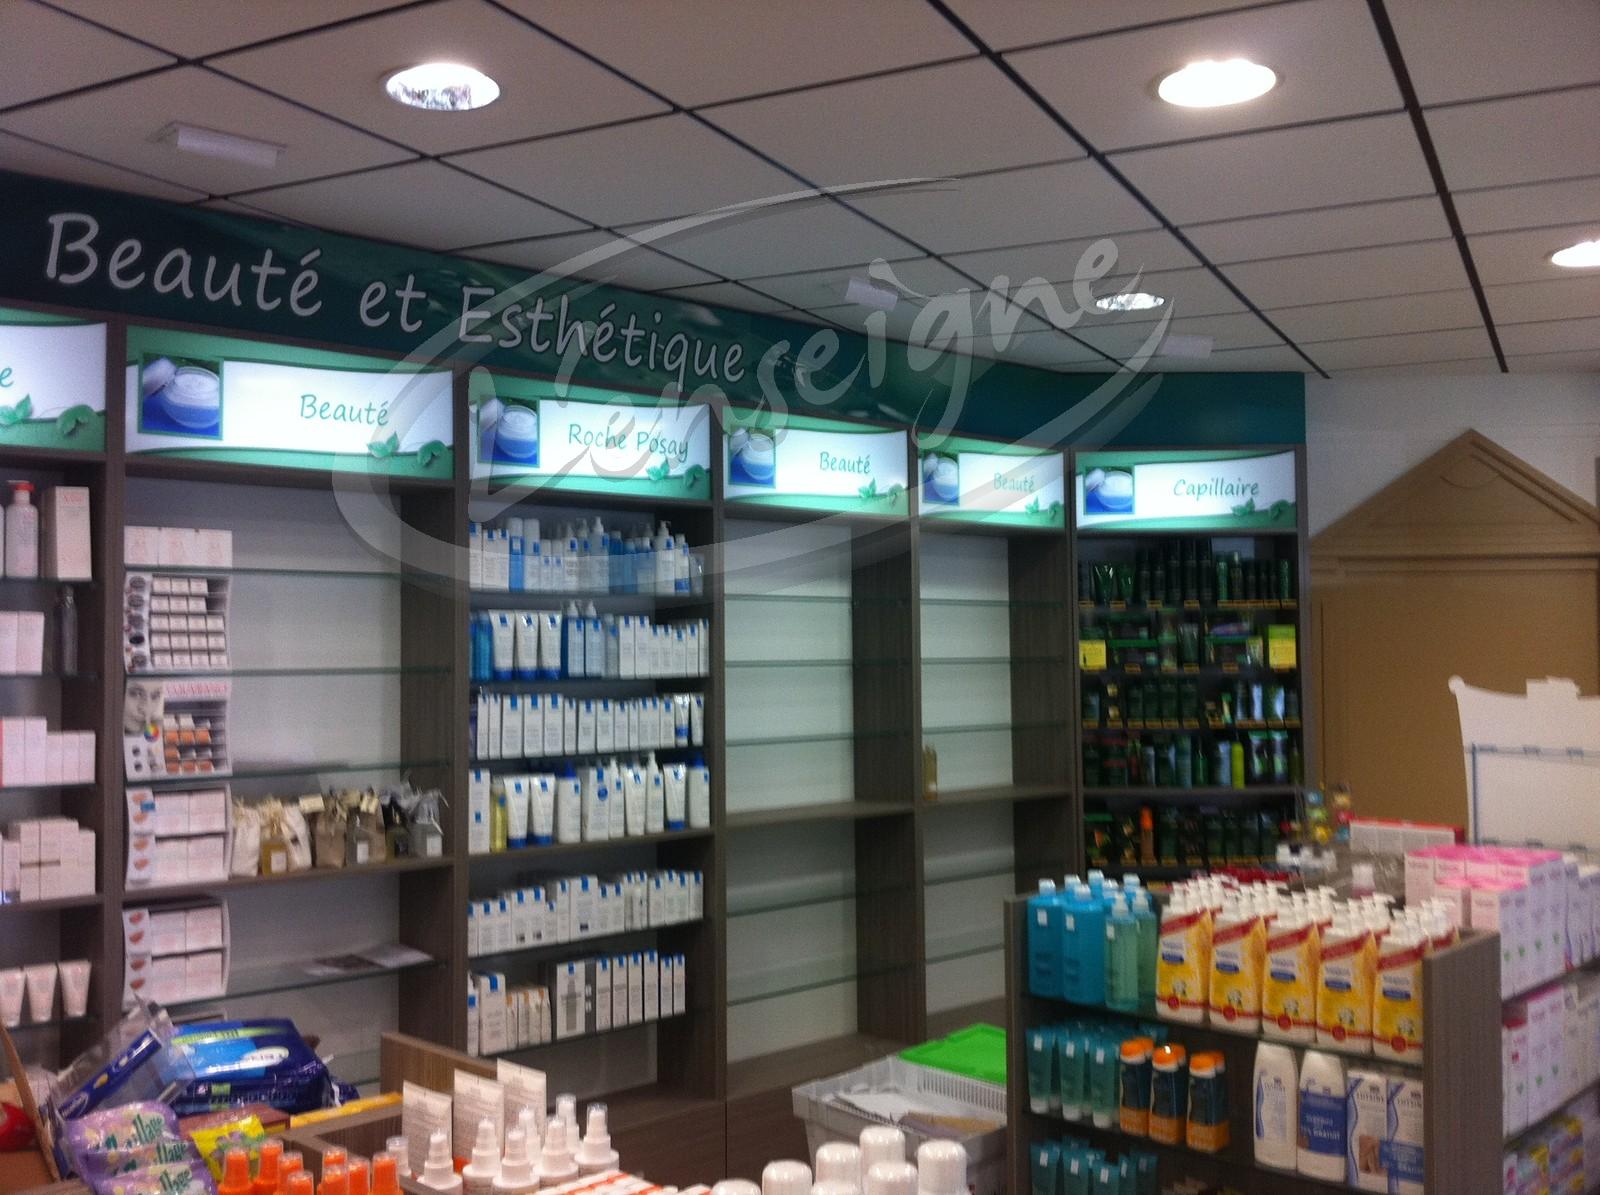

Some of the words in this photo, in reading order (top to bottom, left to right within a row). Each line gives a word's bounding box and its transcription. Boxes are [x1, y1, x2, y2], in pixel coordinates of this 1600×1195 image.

[46, 211, 323, 318] Beauté
[359, 273, 427, 334] et
[458, 286, 746, 393] Esthétique
[299, 393, 390, 428] Beauté
[568, 423, 627, 450] Roche
[636, 431, 689, 463] Posay
[818, 450, 872, 476] Beauté
[992, 470, 1036, 494] Beauté
[1172, 477, 1260, 502] Capillaire
